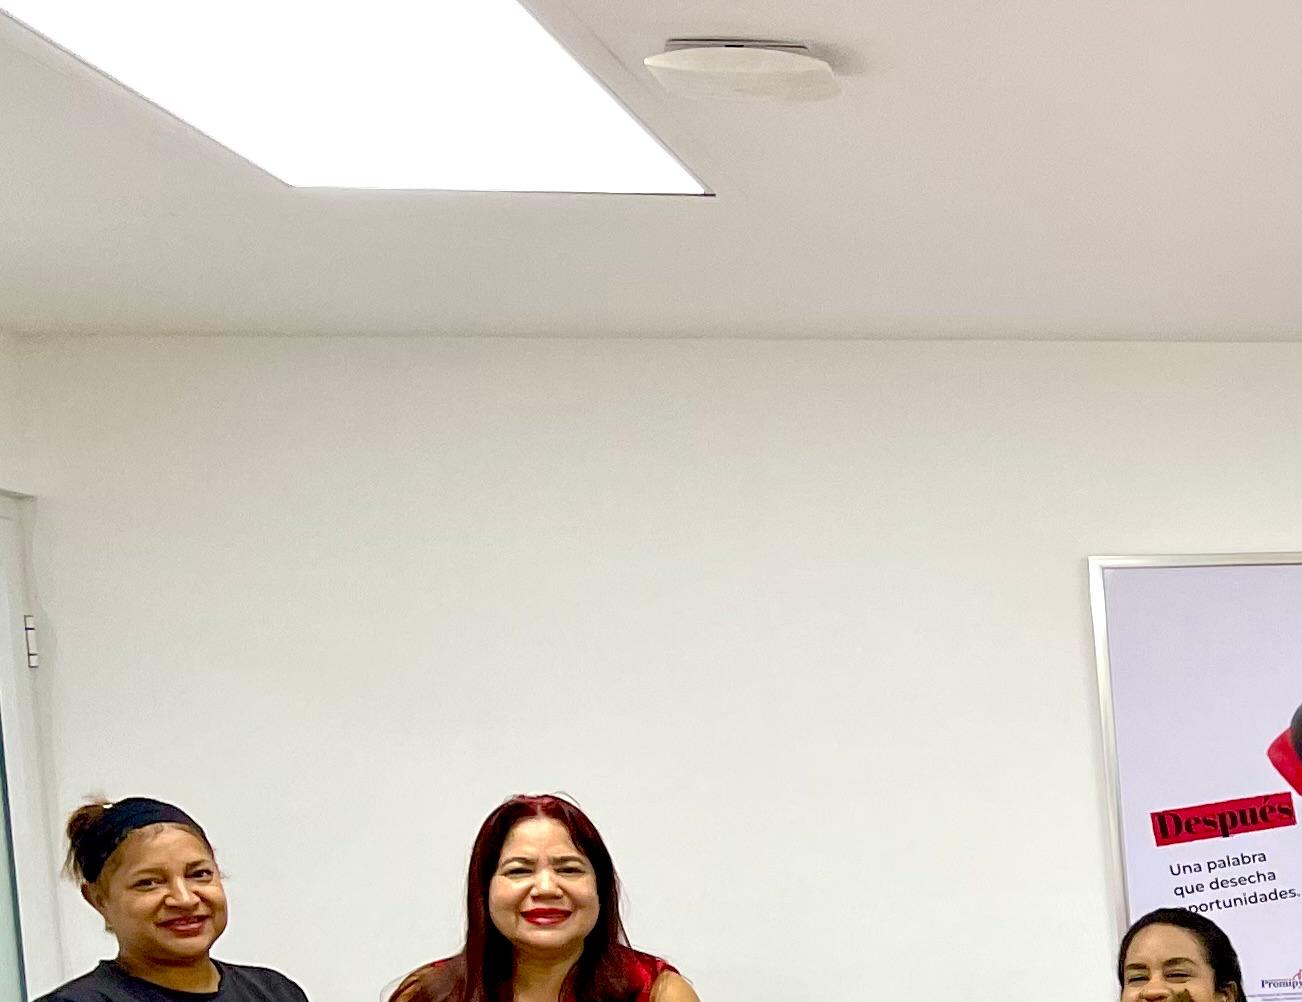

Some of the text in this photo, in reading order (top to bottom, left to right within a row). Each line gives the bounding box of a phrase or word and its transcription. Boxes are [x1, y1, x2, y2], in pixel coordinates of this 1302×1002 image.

[1156, 797, 1293, 838] Después
[1169, 852, 1267, 876] Una palabra
[1174, 871, 1277, 897] que desecha
[1183, 888, 1301, 914] portunidades.
